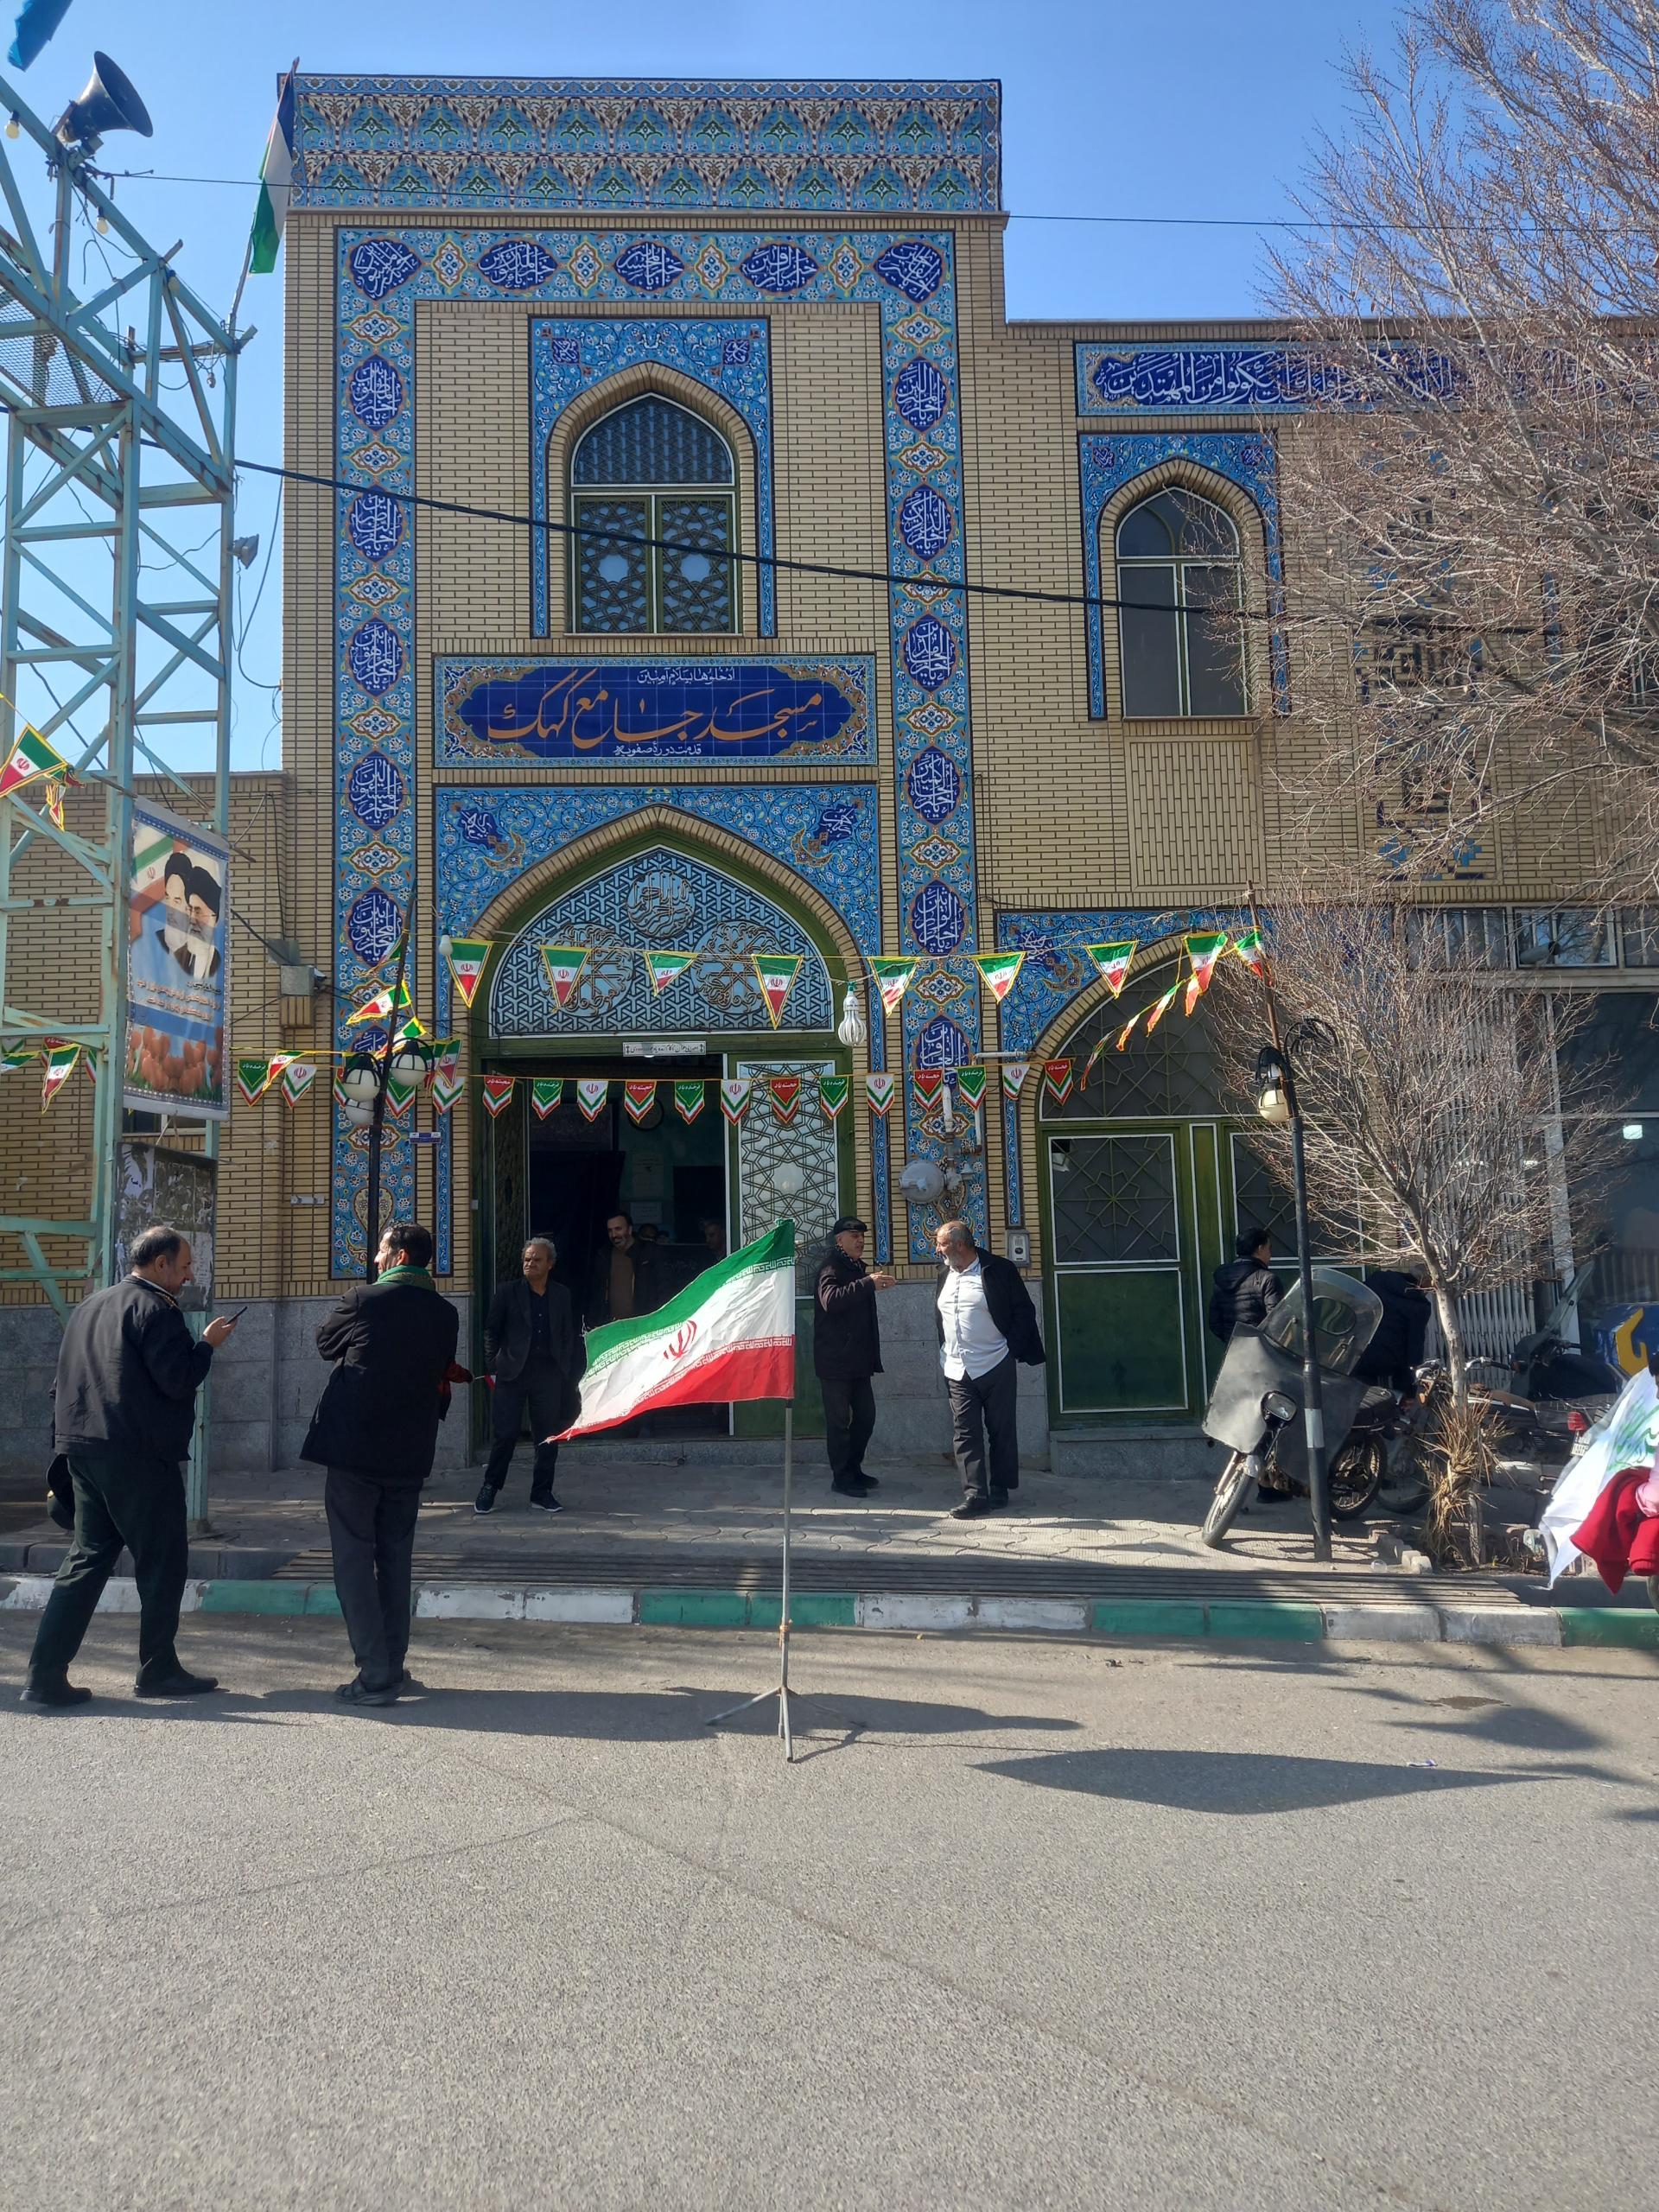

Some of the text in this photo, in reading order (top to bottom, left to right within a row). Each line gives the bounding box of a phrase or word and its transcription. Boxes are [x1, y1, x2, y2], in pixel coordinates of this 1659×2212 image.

[1105, 352, 1195, 404] المهتدين
[572, 690, 703, 750] جامع
[694, 689, 822, 741] مسجد
[613, 743, 652, 757] صفویه
[677, 744, 702, 755] قدمت
